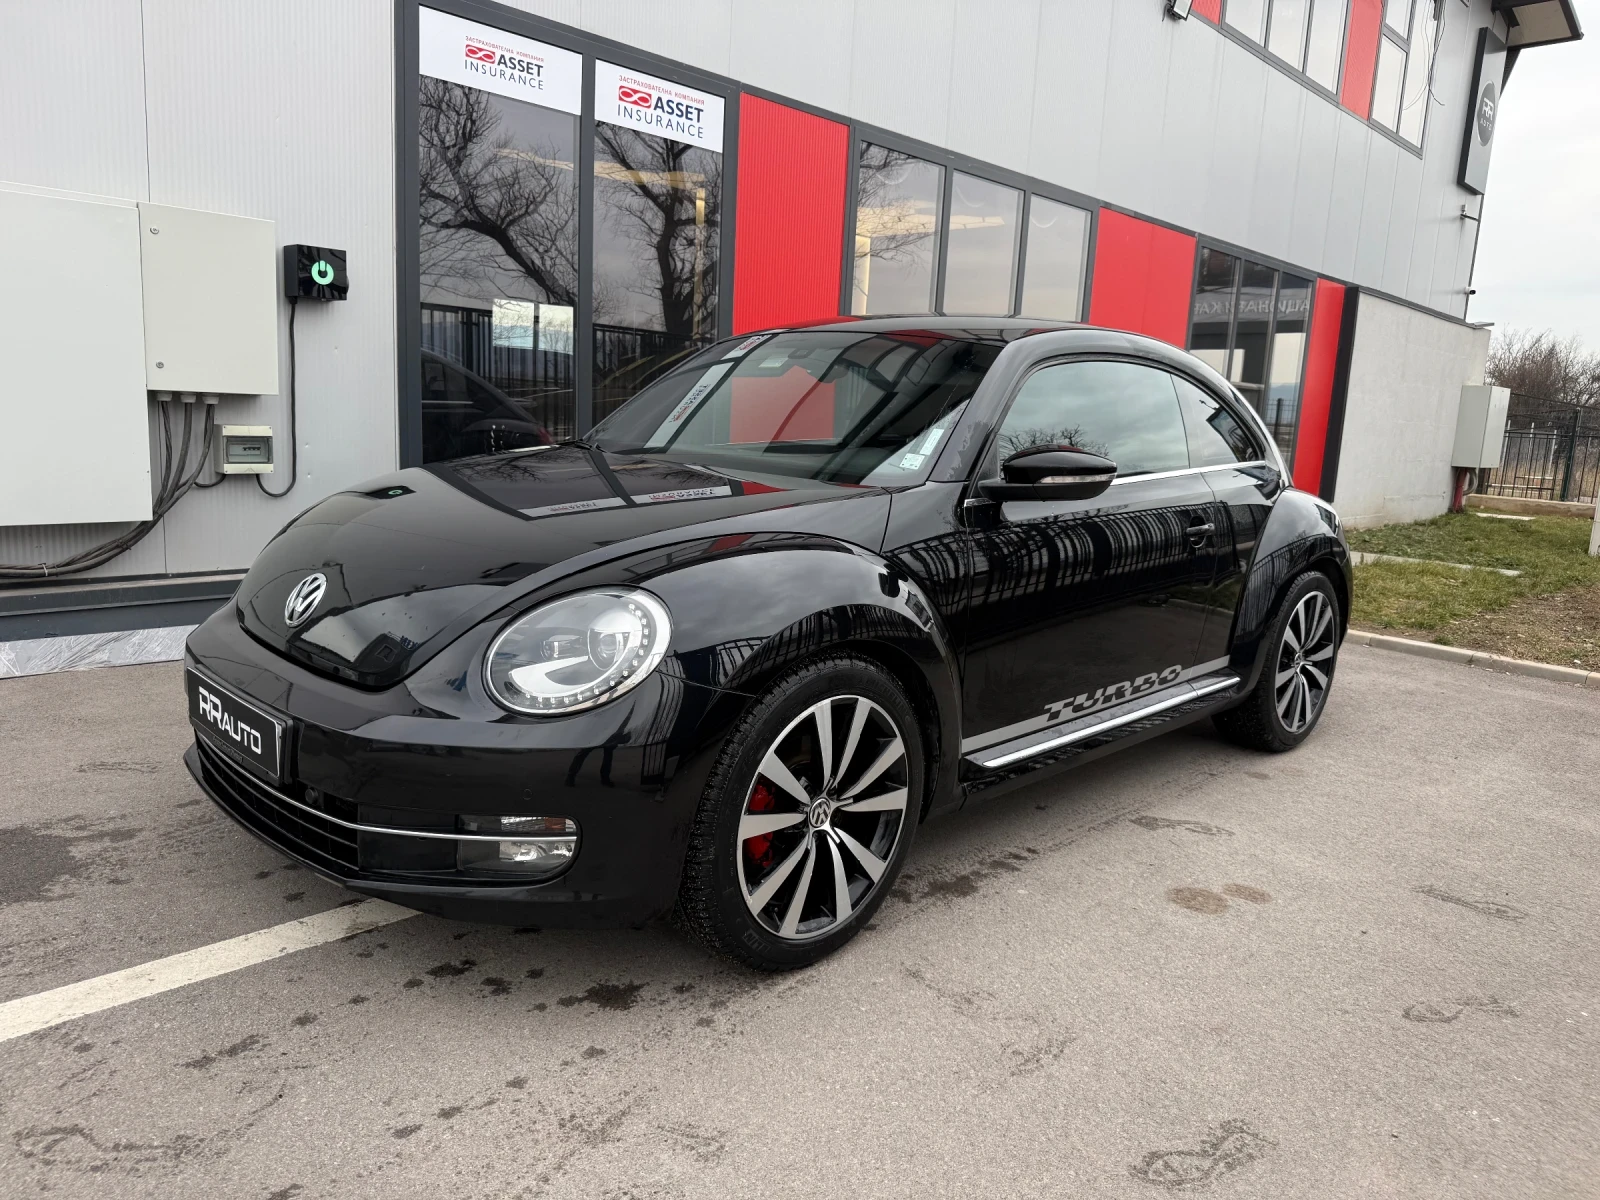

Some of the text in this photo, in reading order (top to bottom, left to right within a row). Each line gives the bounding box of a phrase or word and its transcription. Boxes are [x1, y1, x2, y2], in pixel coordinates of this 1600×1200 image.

[465, 35, 514, 54] ЗАСТРАХОВАТЕЛНА
[464, 59, 544, 91] INSURANCE
[497, 53, 544, 77] ASSET
[618, 74, 705, 106] ЗАСТРАХОВАТЕЛНА КОМПАНИЯ
[617, 104, 704, 139] INSURANCE
[653, 96, 704, 123] ASSET
[1043, 664, 1183, 723] TURBO
